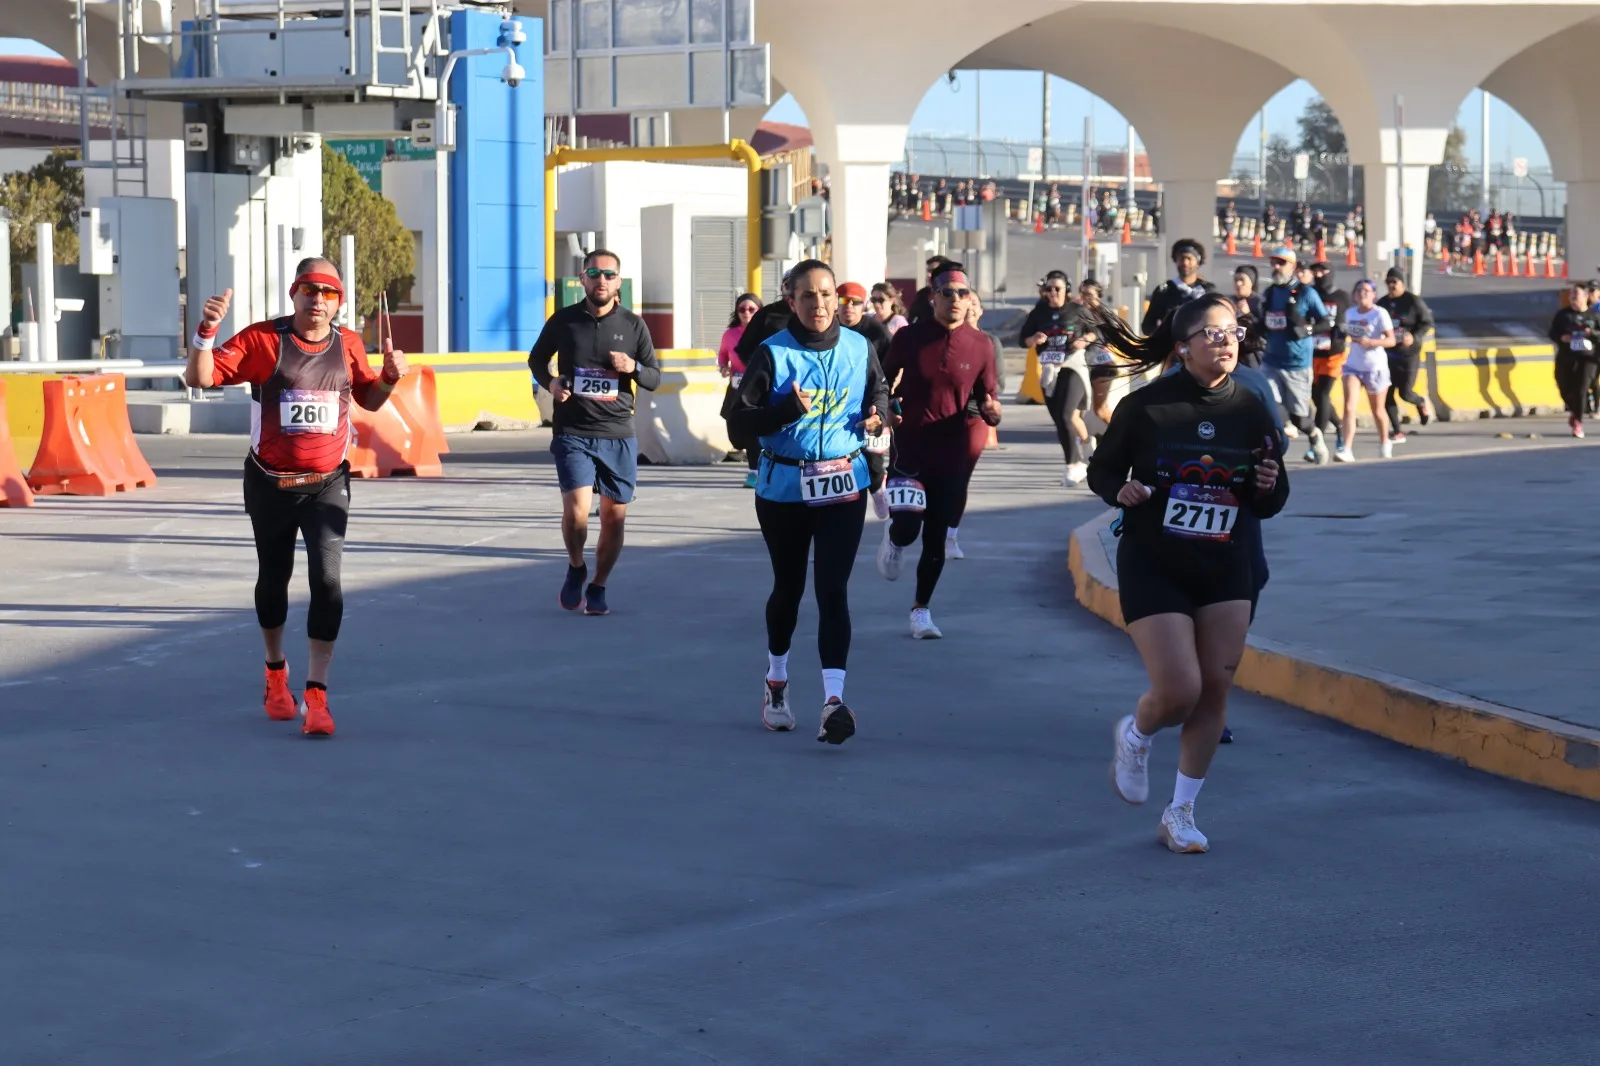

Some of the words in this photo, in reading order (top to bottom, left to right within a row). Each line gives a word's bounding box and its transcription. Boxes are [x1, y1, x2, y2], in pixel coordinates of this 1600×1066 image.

[356, 160, 382, 174] Zaragoz
[582, 379, 611, 394] 259
[290, 404, 329, 424] 260
[279, 473, 321, 488] CHIGO
[806, 473, 854, 498] 1700
[889, 488, 924, 505] 1173
[1169, 502, 1230, 532] 2711
